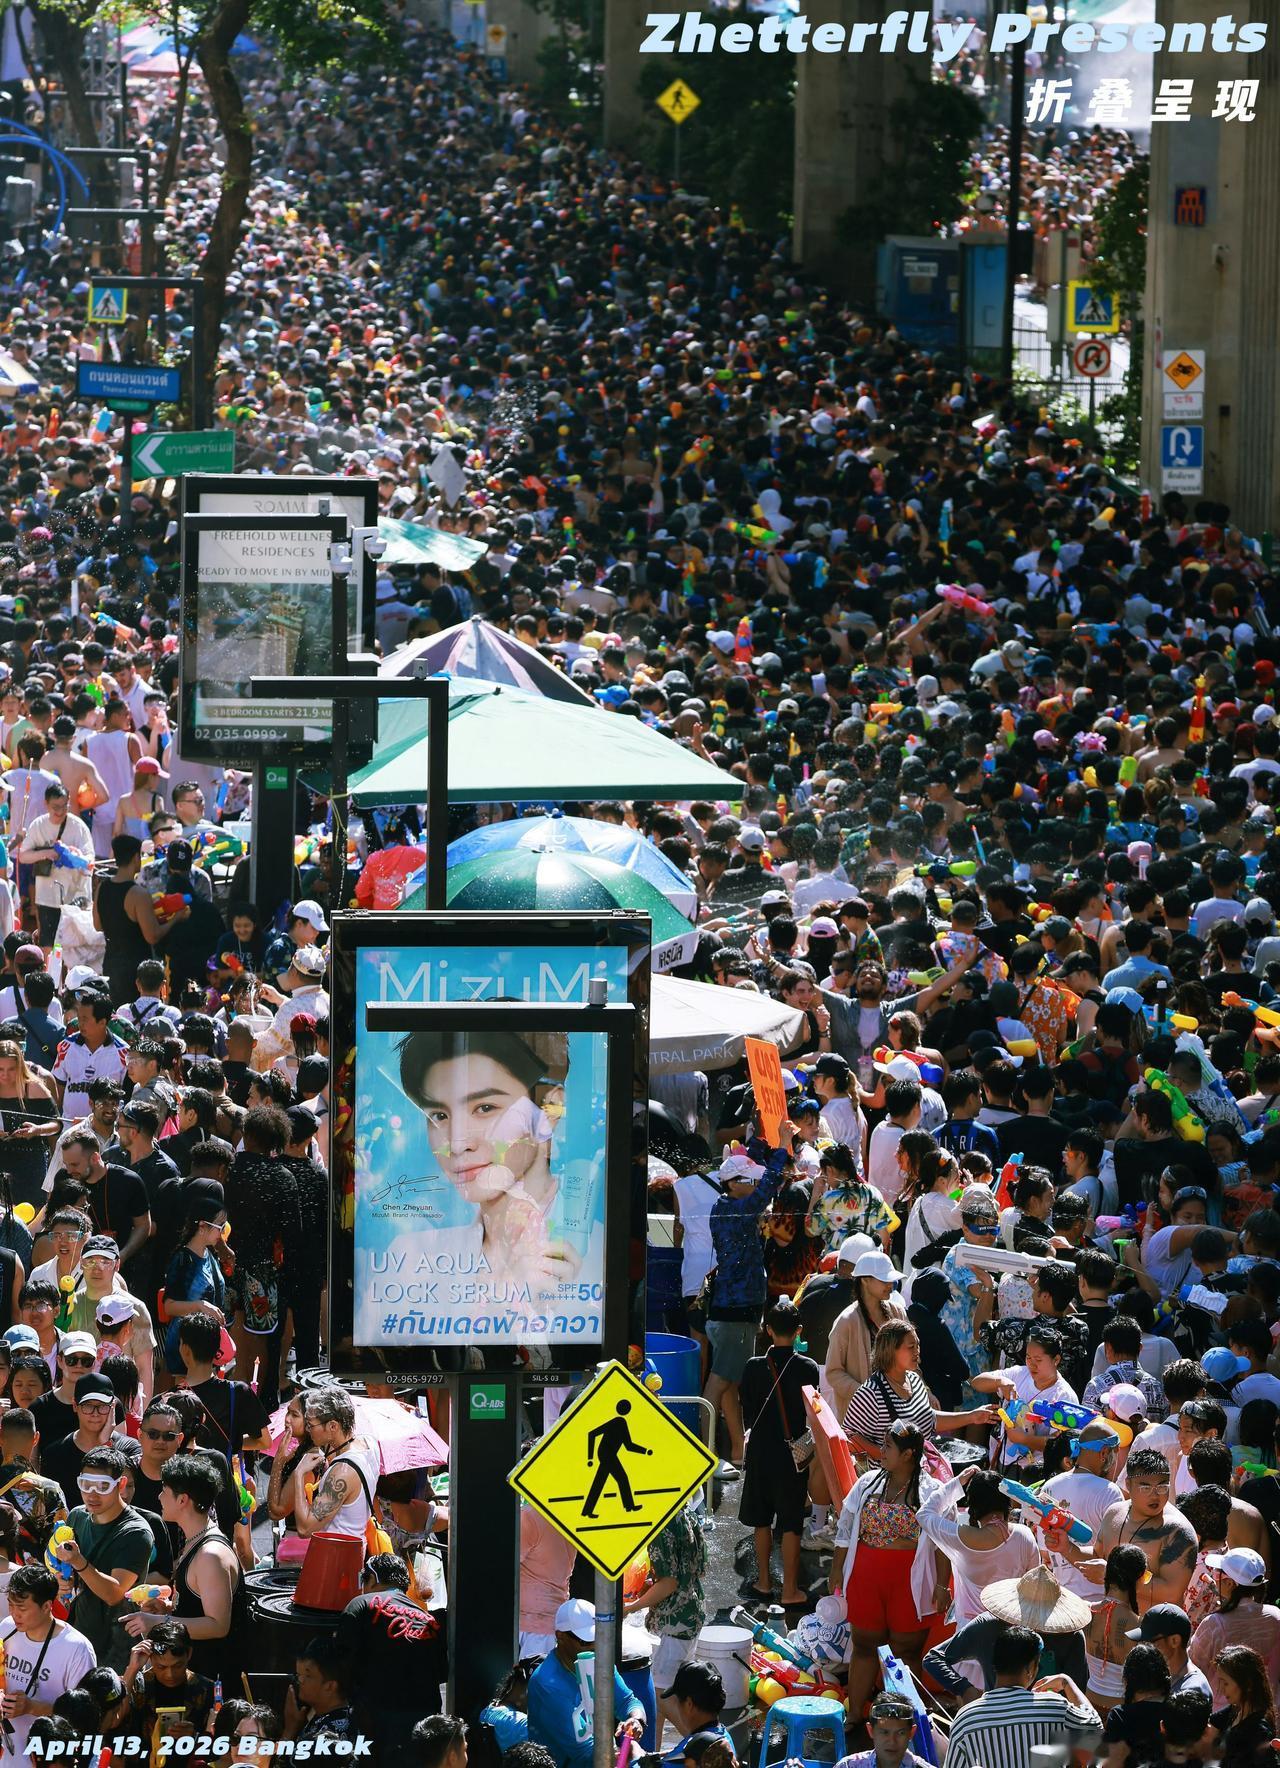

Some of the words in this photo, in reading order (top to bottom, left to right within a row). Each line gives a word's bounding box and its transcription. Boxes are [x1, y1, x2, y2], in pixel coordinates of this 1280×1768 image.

[214, 531, 276, 542] FREEHOLD
[280, 531, 332, 542] WELLNES
[241, 546, 315, 557] RESIDENCES
[198, 567, 231, 576] READY
[234, 567, 247, 576] TO
[250, 567, 278, 576] MOVE
[281, 568, 292, 576] IN
[295, 568, 307, 577] BY
[310, 568, 330, 577] MID
[220, 708, 262, 717] BEDROOM
[264, 708, 294, 717] STARTS
[296, 707, 319, 718] 21.9
[194, 728, 210, 739] 02
[214, 729, 239, 739] 035
[243, 729, 277, 739] 0999
[380, 960, 607, 1002] MizuM
[646, 1049, 691, 1065] TRAL
[693, 1046, 734, 1060] PARK
[403, 1204, 433, 1213] Zheyuan
[370, 1251, 406, 1273] UV
[415, 1251, 492, 1275] AQUA
[370, 1281, 439, 1304] LOCK
[450, 1281, 532, 1304] SERUM
[557, 1284, 577, 1292] SPF
[386, 1375, 443, 1384] 02-965-9797
[4, 1654, 51, 1682] ADIDS
[5, 1672, 31, 1683] THLET
